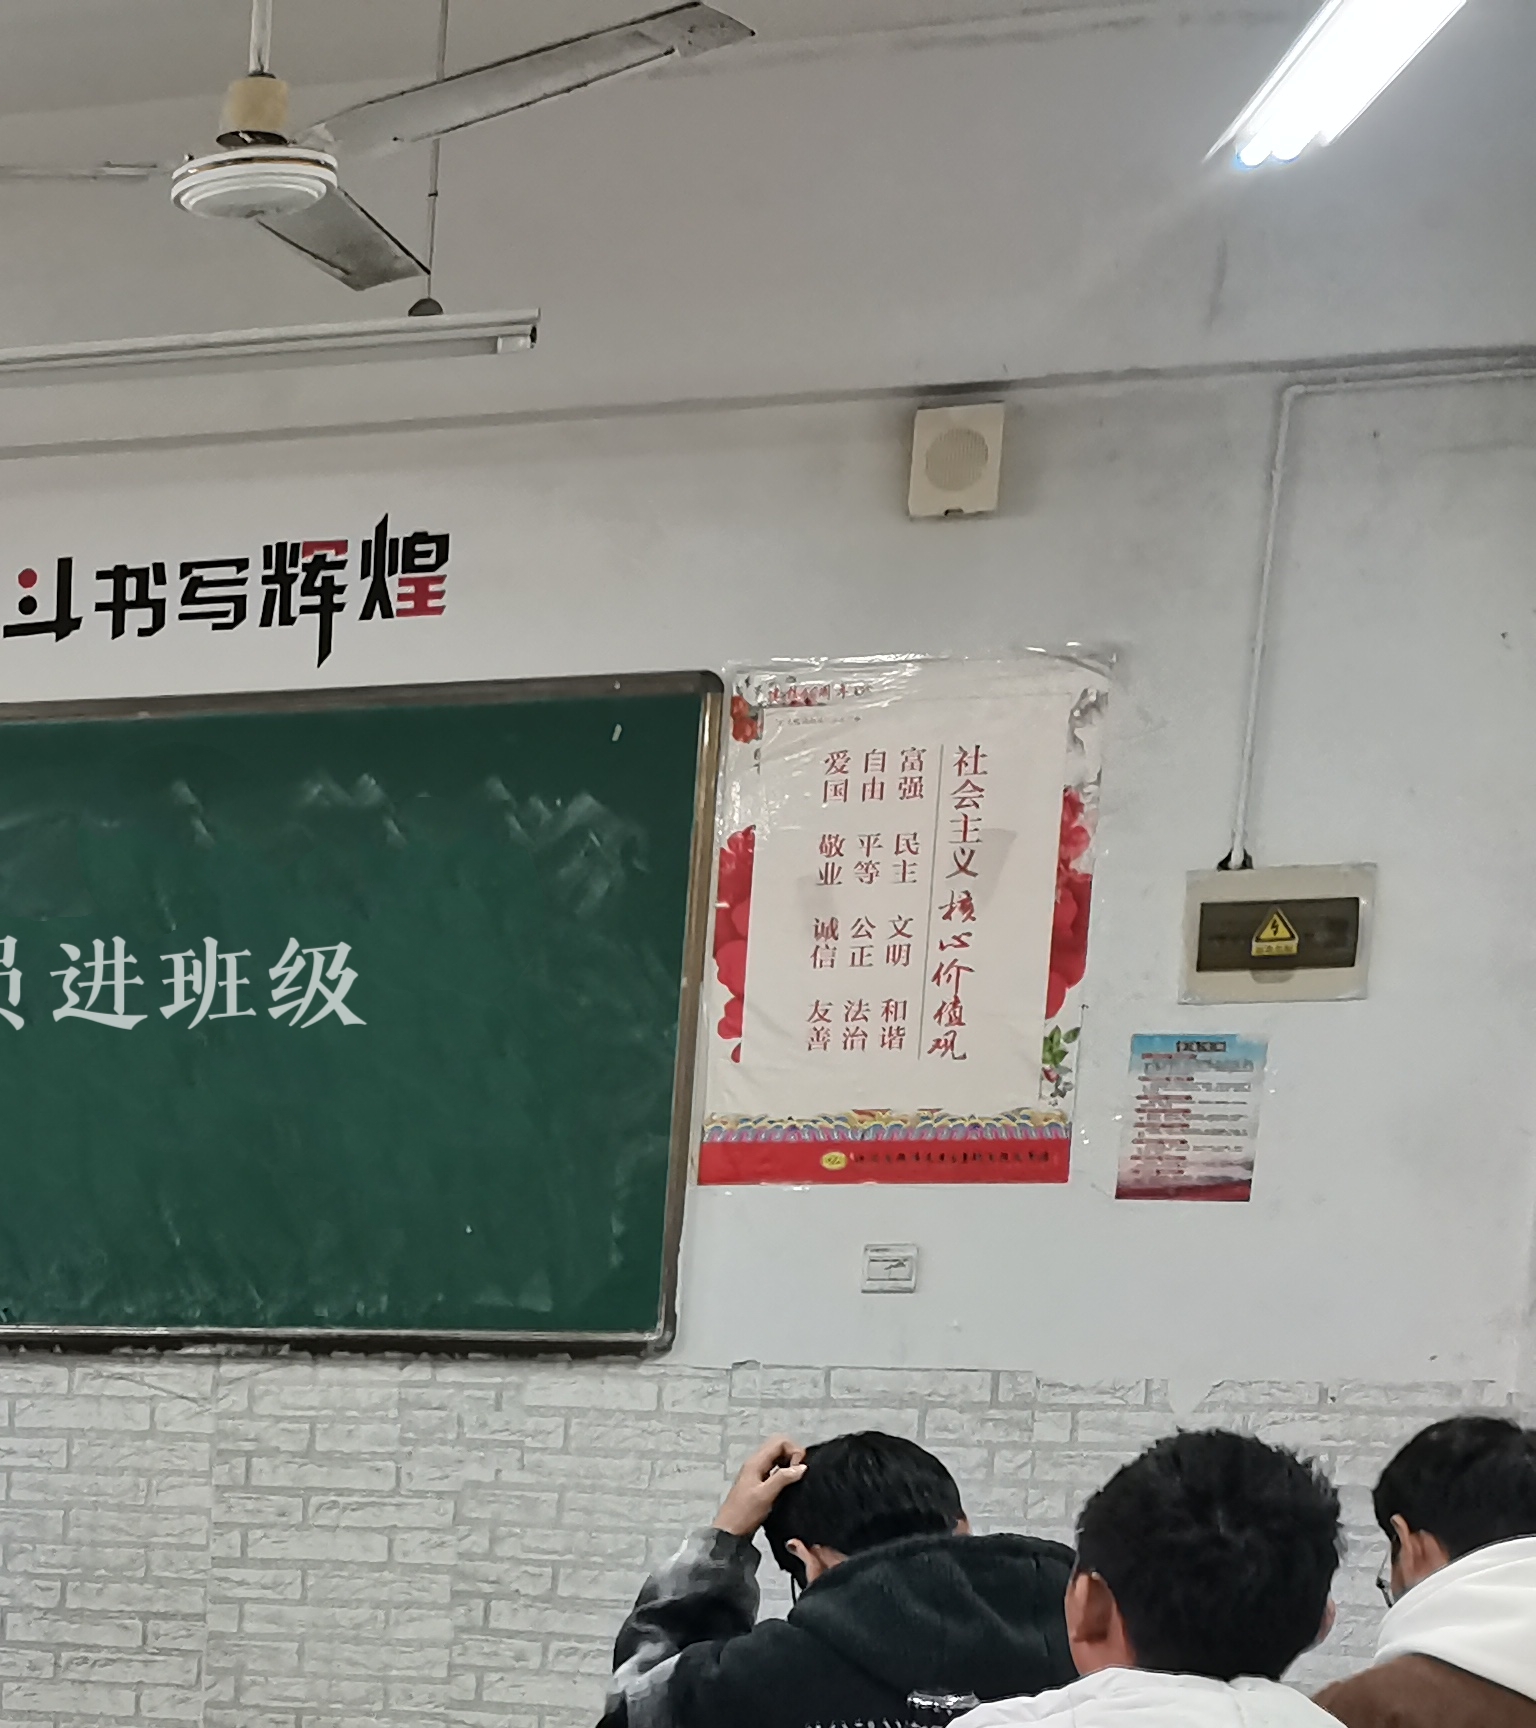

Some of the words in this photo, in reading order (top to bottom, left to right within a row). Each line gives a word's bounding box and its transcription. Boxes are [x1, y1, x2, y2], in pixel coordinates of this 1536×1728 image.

[822, 748, 851, 803] 爱国
[861, 748, 888, 803] 自由
[897, 746, 927, 802] 富强
[814, 832, 846, 887] 敬业
[854, 832, 884, 885] 平等
[892, 832, 920, 886] 民主
[926, 745, 989, 1062] 社会主义核心价值观
[810, 916, 840, 970] 诚信
[848, 915, 877, 969] 公正
[885, 914, 914, 968] 文明
[805, 1000, 834, 1053] 友善
[842, 999, 870, 1052] 法治
[879, 997, 909, 1052] 和谐
